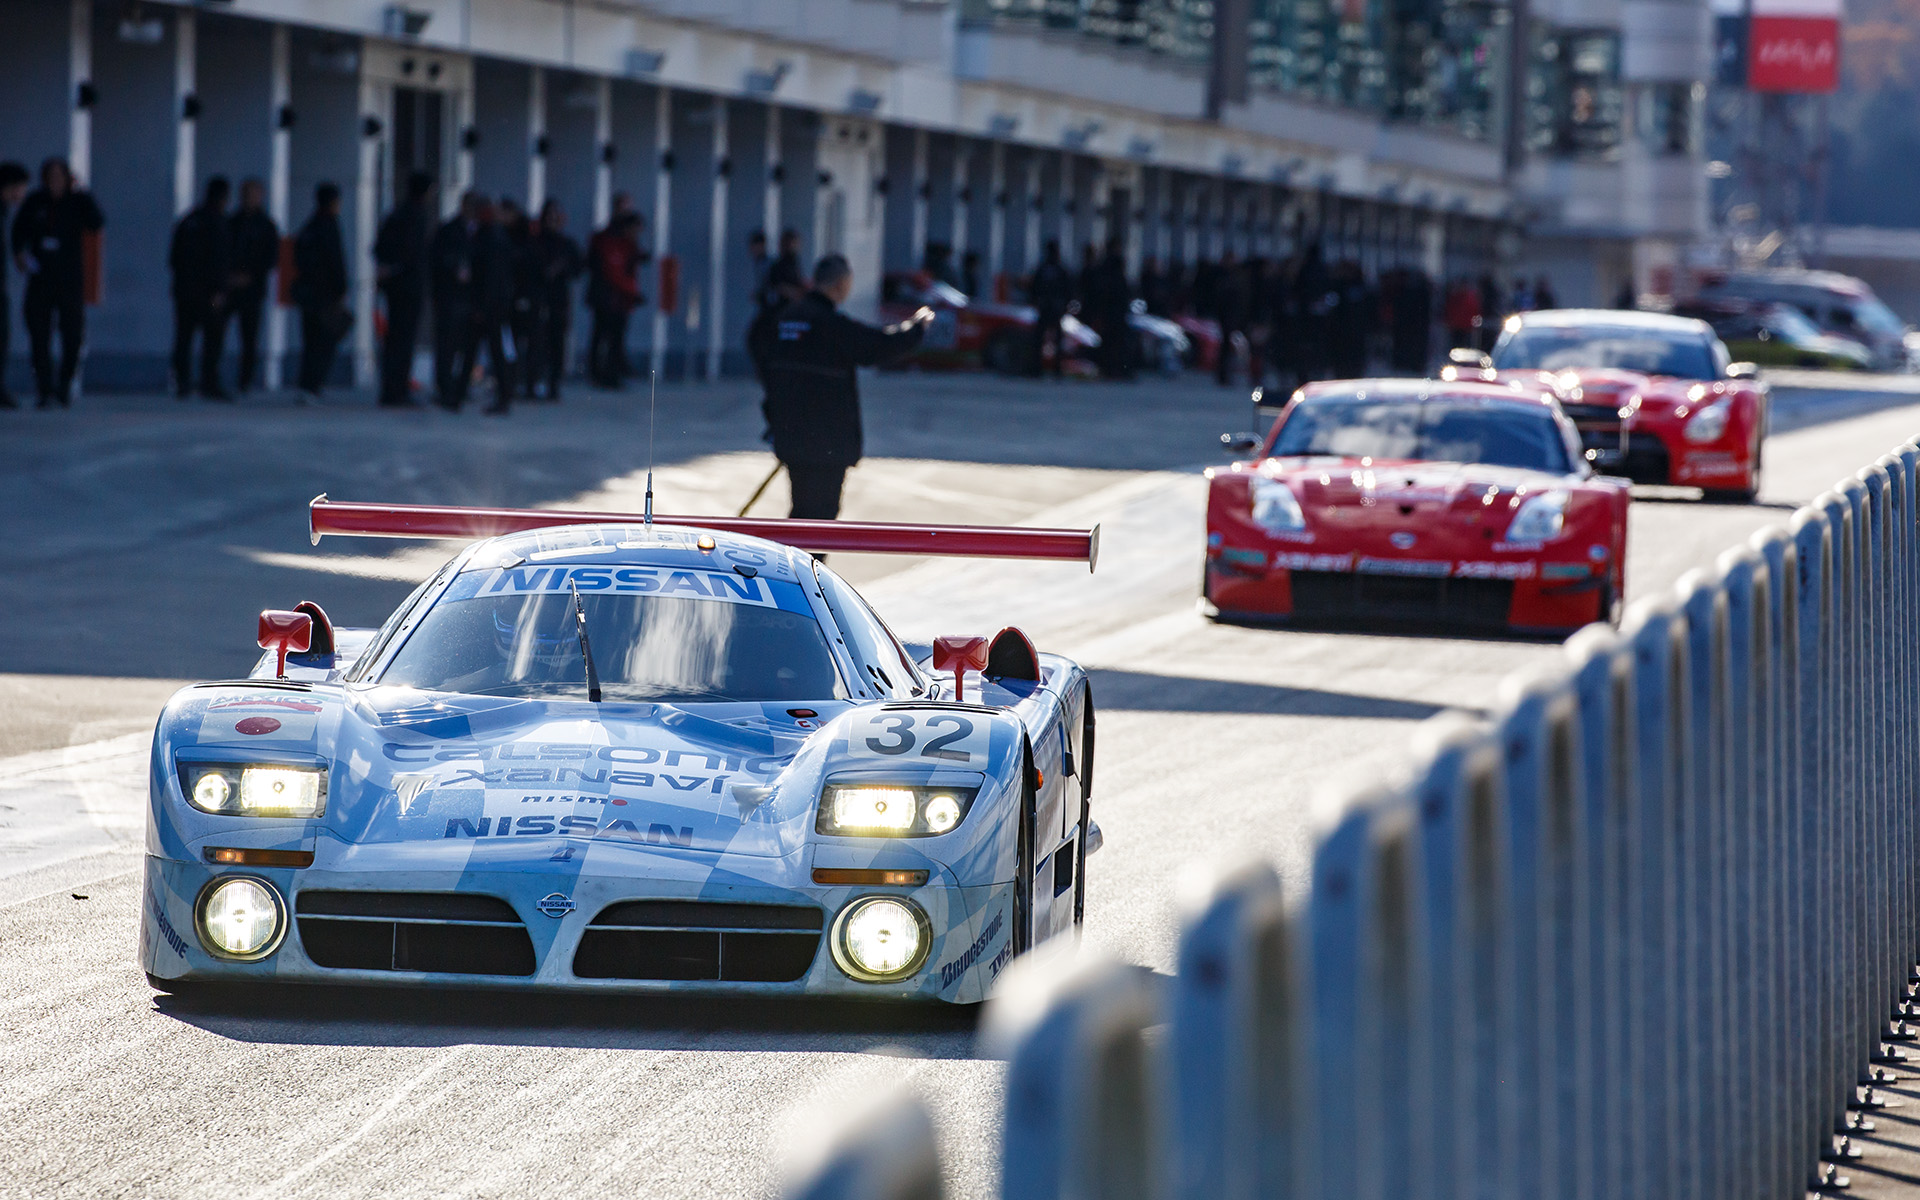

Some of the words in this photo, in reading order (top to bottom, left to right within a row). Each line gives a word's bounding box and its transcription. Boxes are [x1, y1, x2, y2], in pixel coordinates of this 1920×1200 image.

[489, 568, 763, 602] NISSAN
[865, 714, 974, 762] 32
[382, 742, 796, 775] calsonic
[440, 767, 731, 794] xanavi
[444, 815, 694, 847] NISSAN
[942, 908, 1002, 990] BRIDGESTONE
